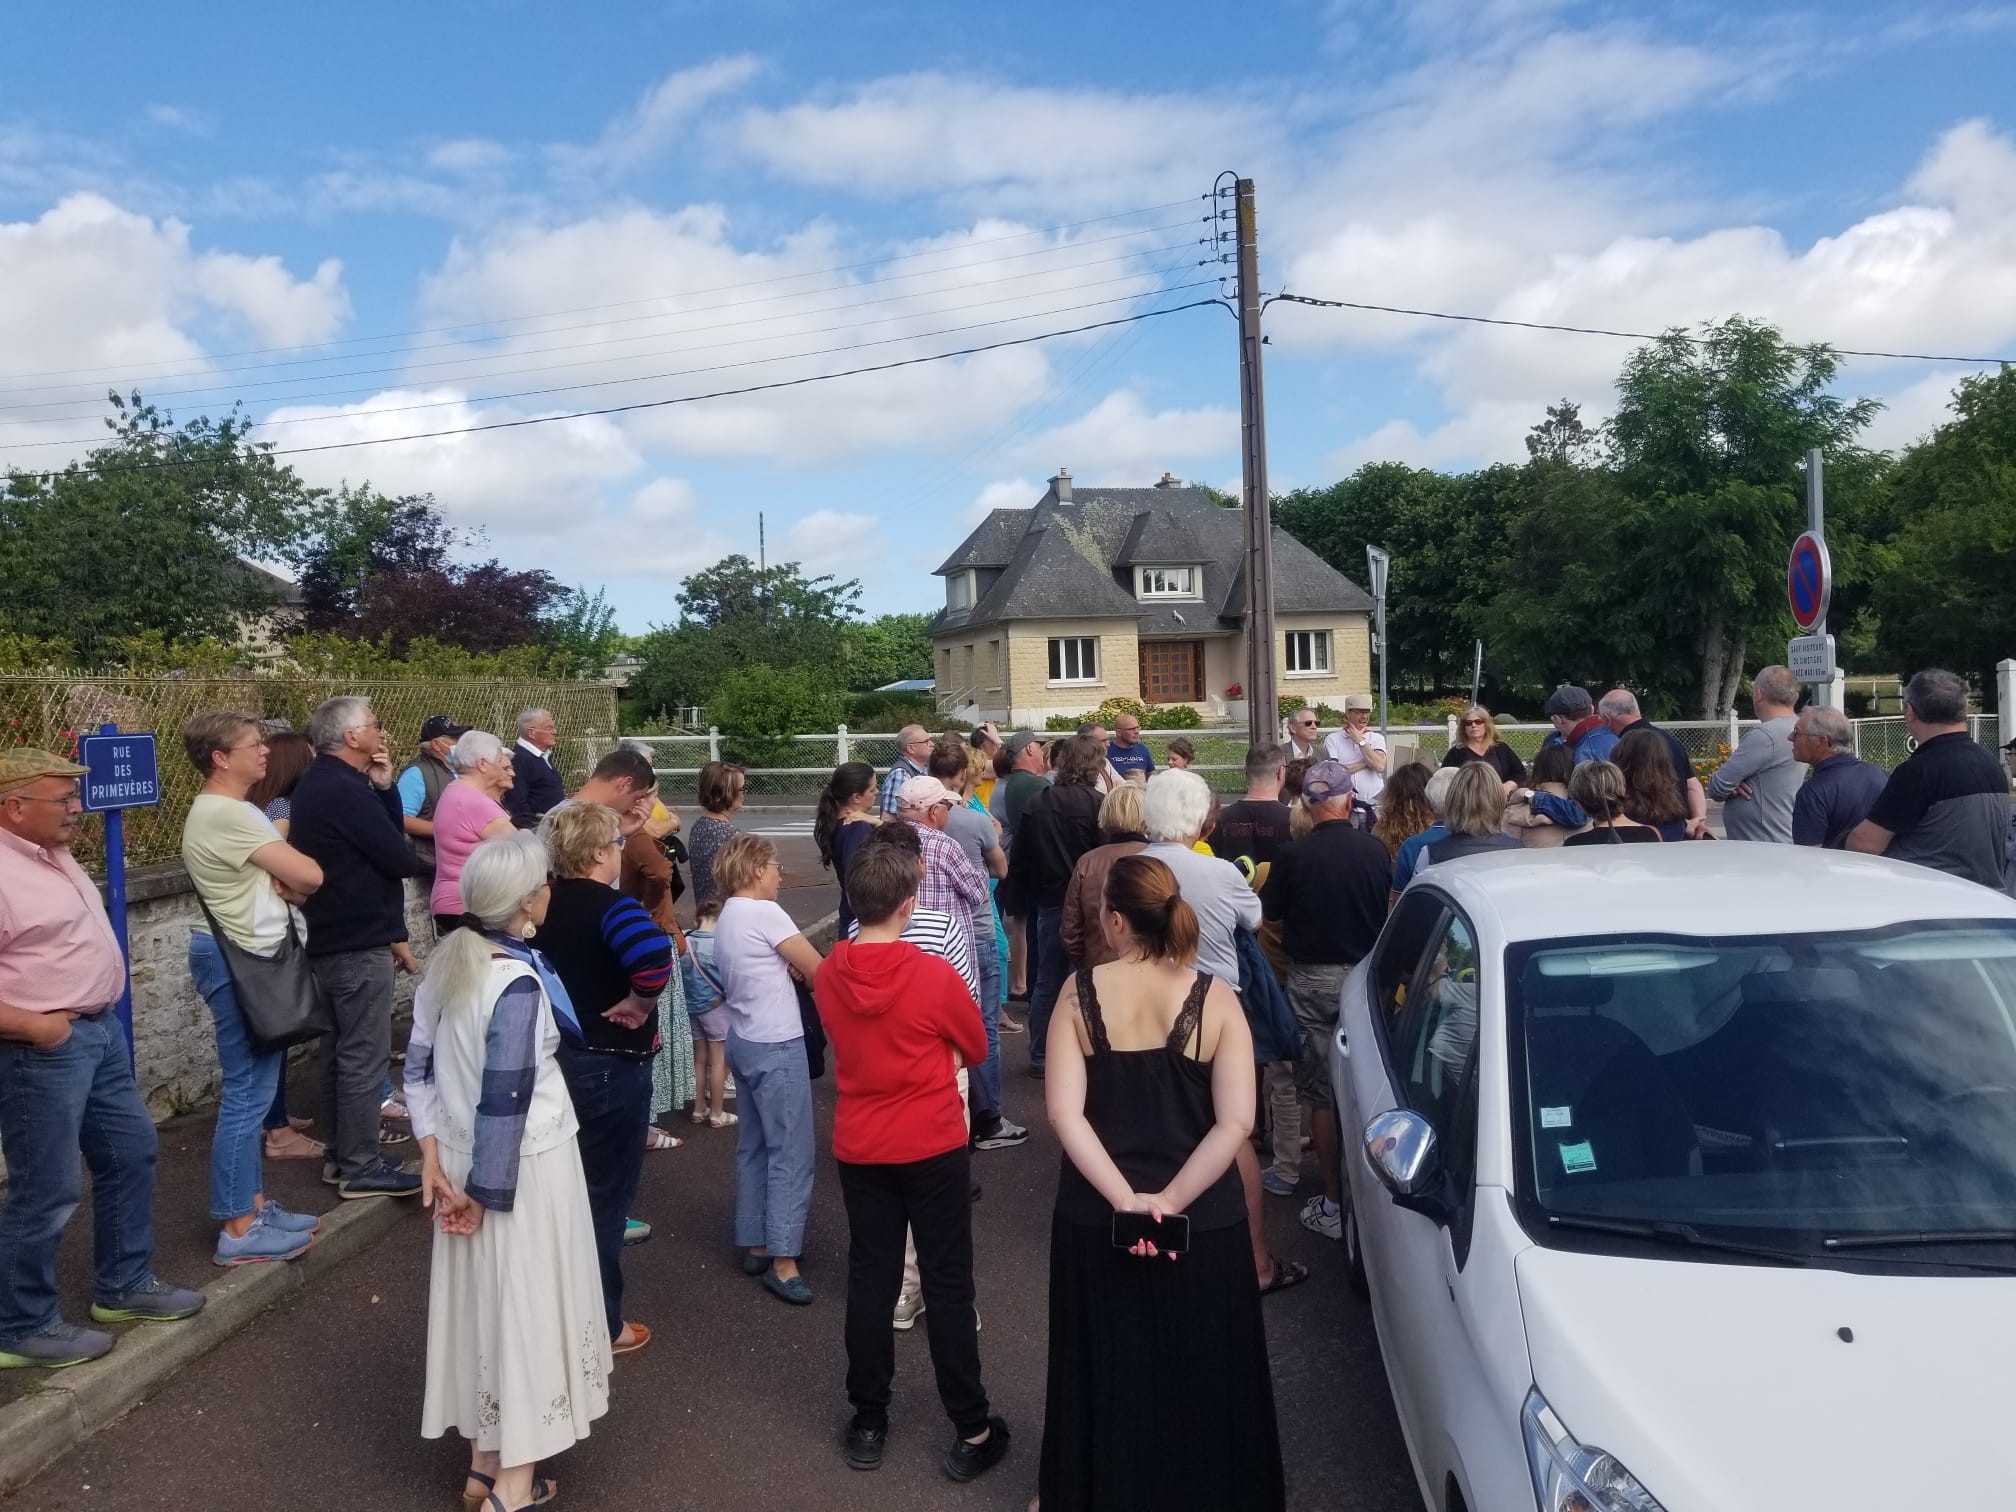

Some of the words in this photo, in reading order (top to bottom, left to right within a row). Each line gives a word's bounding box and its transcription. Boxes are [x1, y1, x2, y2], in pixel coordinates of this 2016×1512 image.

[113, 746, 131, 758] RUE
[114, 764, 131, 776] DES
[92, 780, 153, 799] PRIMEVÈRES
